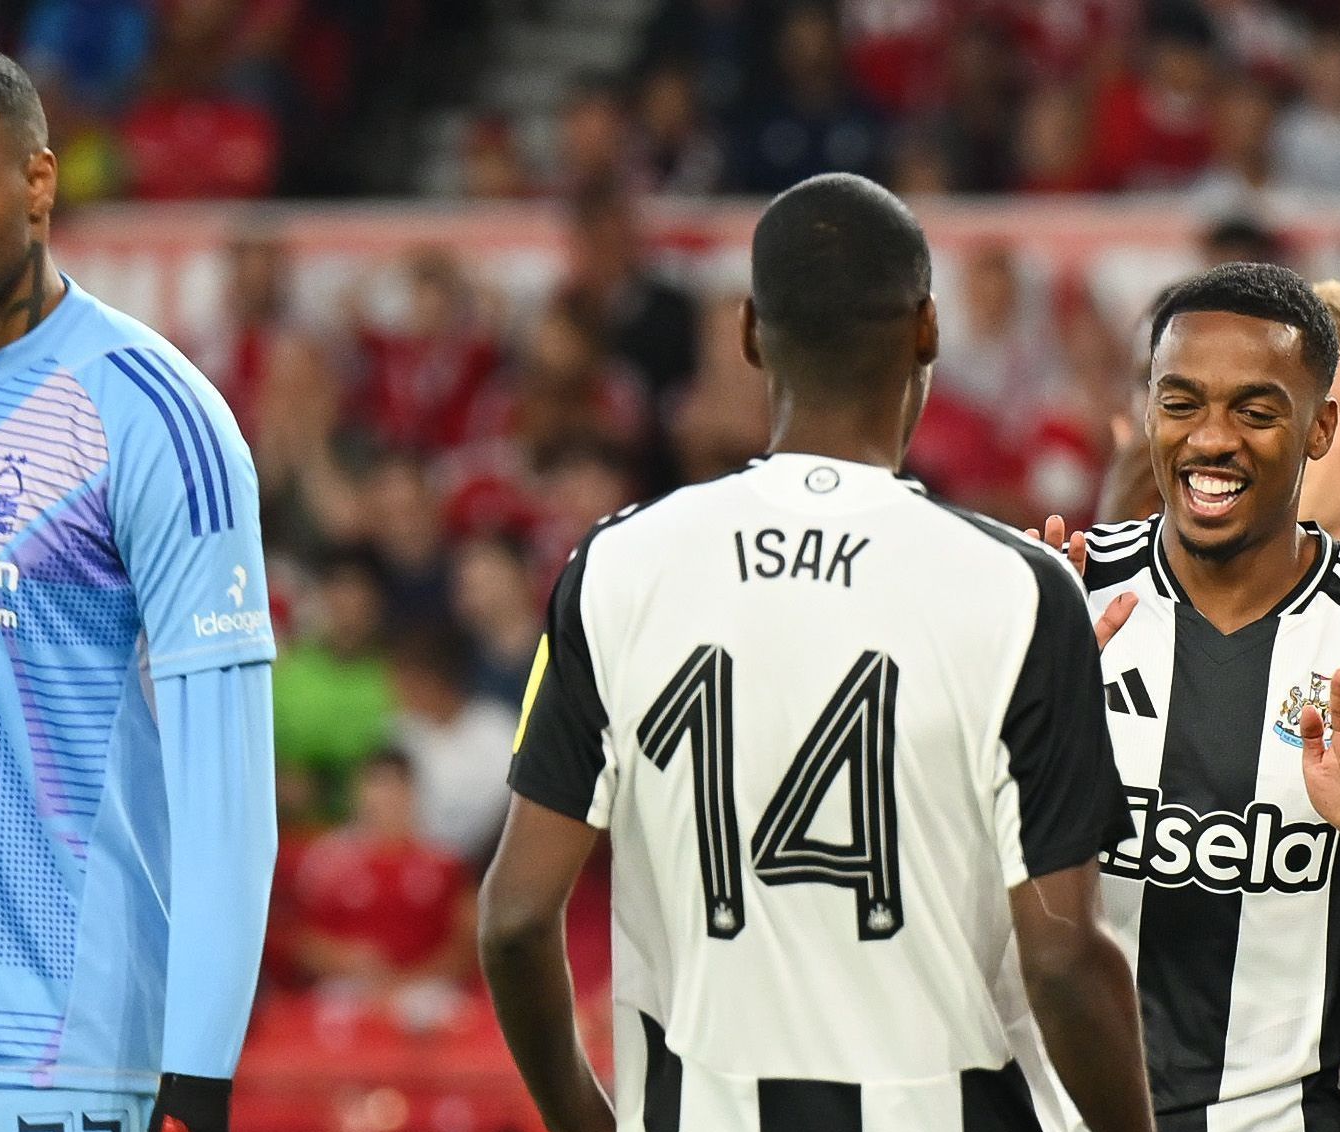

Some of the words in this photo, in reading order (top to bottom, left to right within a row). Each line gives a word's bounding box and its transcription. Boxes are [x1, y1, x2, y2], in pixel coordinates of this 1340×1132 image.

[734, 528, 871, 588] ISAK
[636, 644, 905, 942] 14
[1149, 812, 1329, 885] sela
